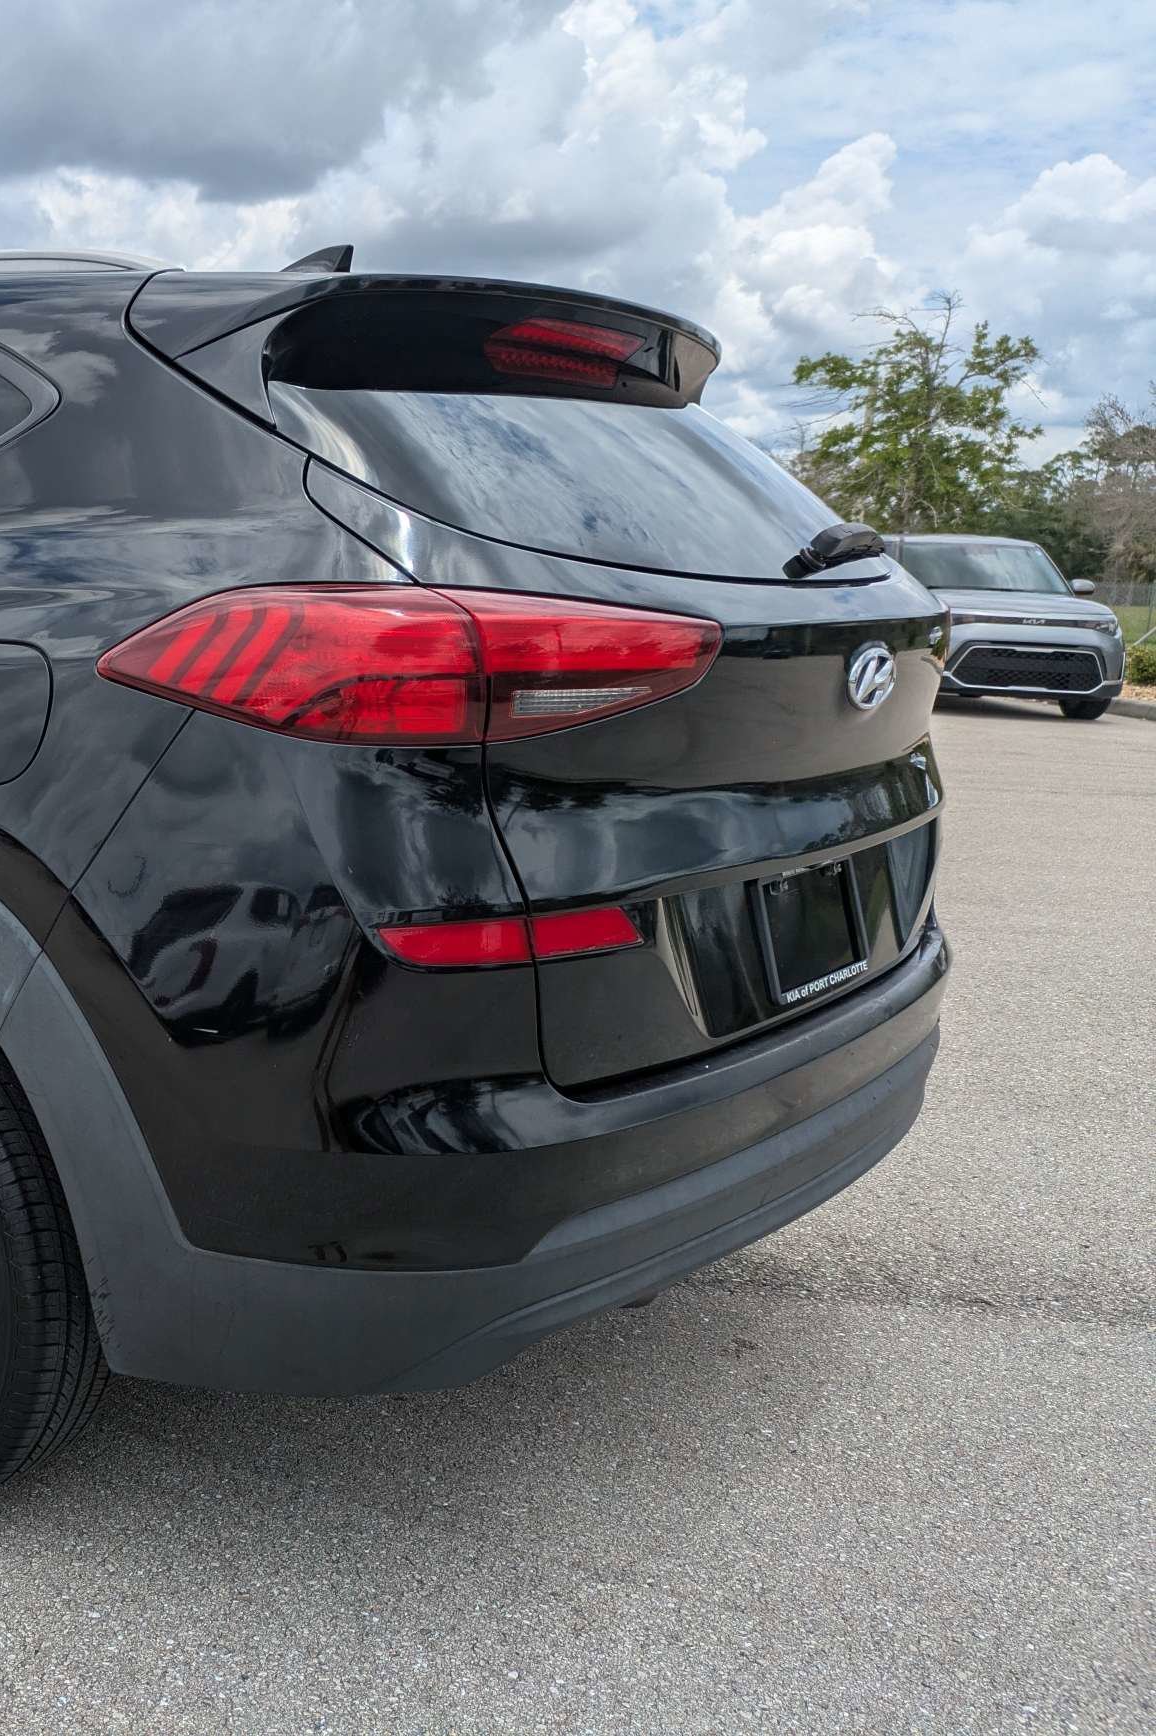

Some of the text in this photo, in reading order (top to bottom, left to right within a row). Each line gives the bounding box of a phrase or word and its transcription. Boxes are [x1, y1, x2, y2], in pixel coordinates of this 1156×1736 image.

[786, 960, 869, 1003] KIA of PORT CHARLOTTE
